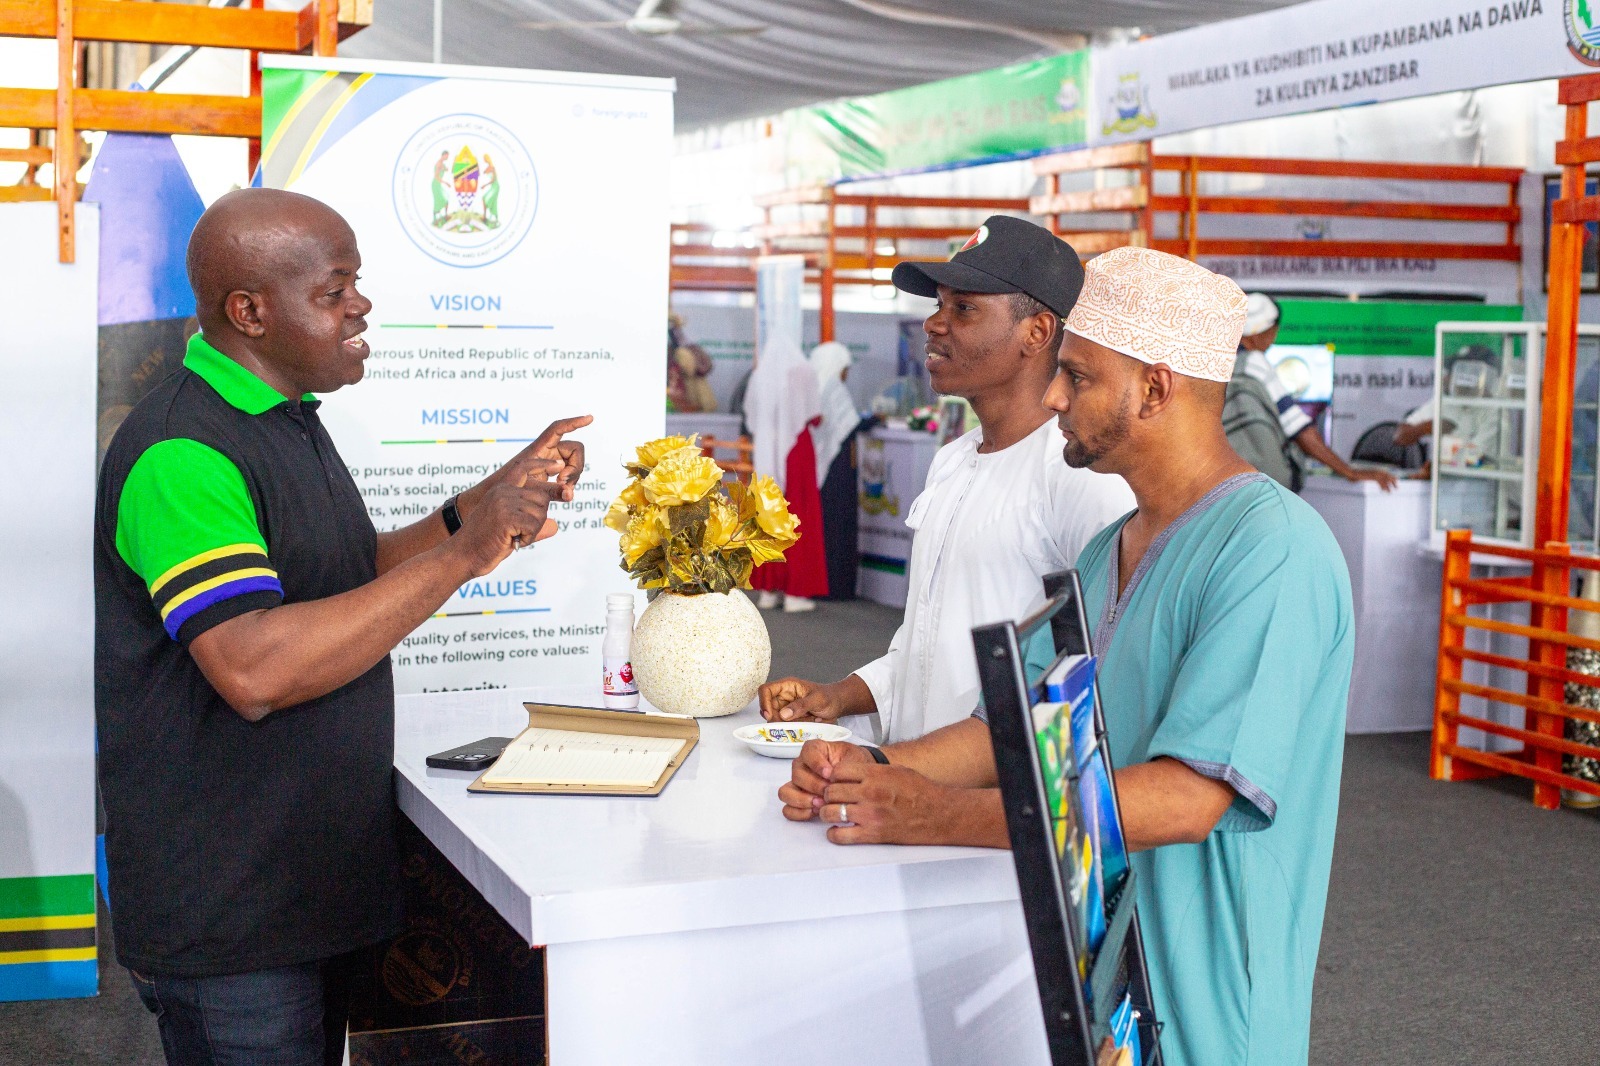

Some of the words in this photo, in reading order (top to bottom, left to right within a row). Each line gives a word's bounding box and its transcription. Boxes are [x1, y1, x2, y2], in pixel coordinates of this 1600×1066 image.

[1168, 63, 1230, 91] MAMLAKA
[1232, 60, 1250, 78] YA
[1253, 45, 1323, 75] KUDHIBITI
[1325, 39, 1348, 60] NA
[1351, 17, 1453, 55] KUPAMBANA
[1458, 10, 1483, 33] NA
[1488, 0, 1543, 27] DAWA
[1255, 86, 1273, 106] ZA
[1276, 75, 1340, 102] KULEVYA
[1342, 60, 1419, 91] ZANZIBAR
[430, 295, 501, 311] VISION
[369, 350, 414, 361] erous
[418, 347, 464, 360] United
[469, 348, 529, 362] Republic
[534, 348, 548, 360] of
[551, 348, 615, 361] Tanzania,
[364, 367, 410, 379] United
[415, 367, 457, 379] Africa
[460, 367, 486, 379] and
[490, 371, 497, 379] a
[500, 368, 527, 381] just
[532, 367, 574, 379] World
[422, 409, 509, 425] MISSION
[364, 465, 414, 479] pursue
[418, 463, 489, 478] diplomacy
[360, 483, 400, 497] ania's
[404, 482, 447, 496] social,
[574, 479, 607, 491] omic
[390, 503, 428, 516] while
[562, 498, 610, 512] dignity
[573, 518, 587, 530] of
[458, 580, 537, 599] VALUES
[402, 632, 450, 649] quality
[453, 631, 467, 643] of
[470, 628, 529, 642] services,
[532, 628, 553, 639] the
[559, 624, 608, 637] Ministr
[398, 654, 411, 666] in
[415, 653, 438, 665] the
[442, 649, 505, 664] following
[509, 647, 539, 659] core
[543, 644, 590, 657] values:
